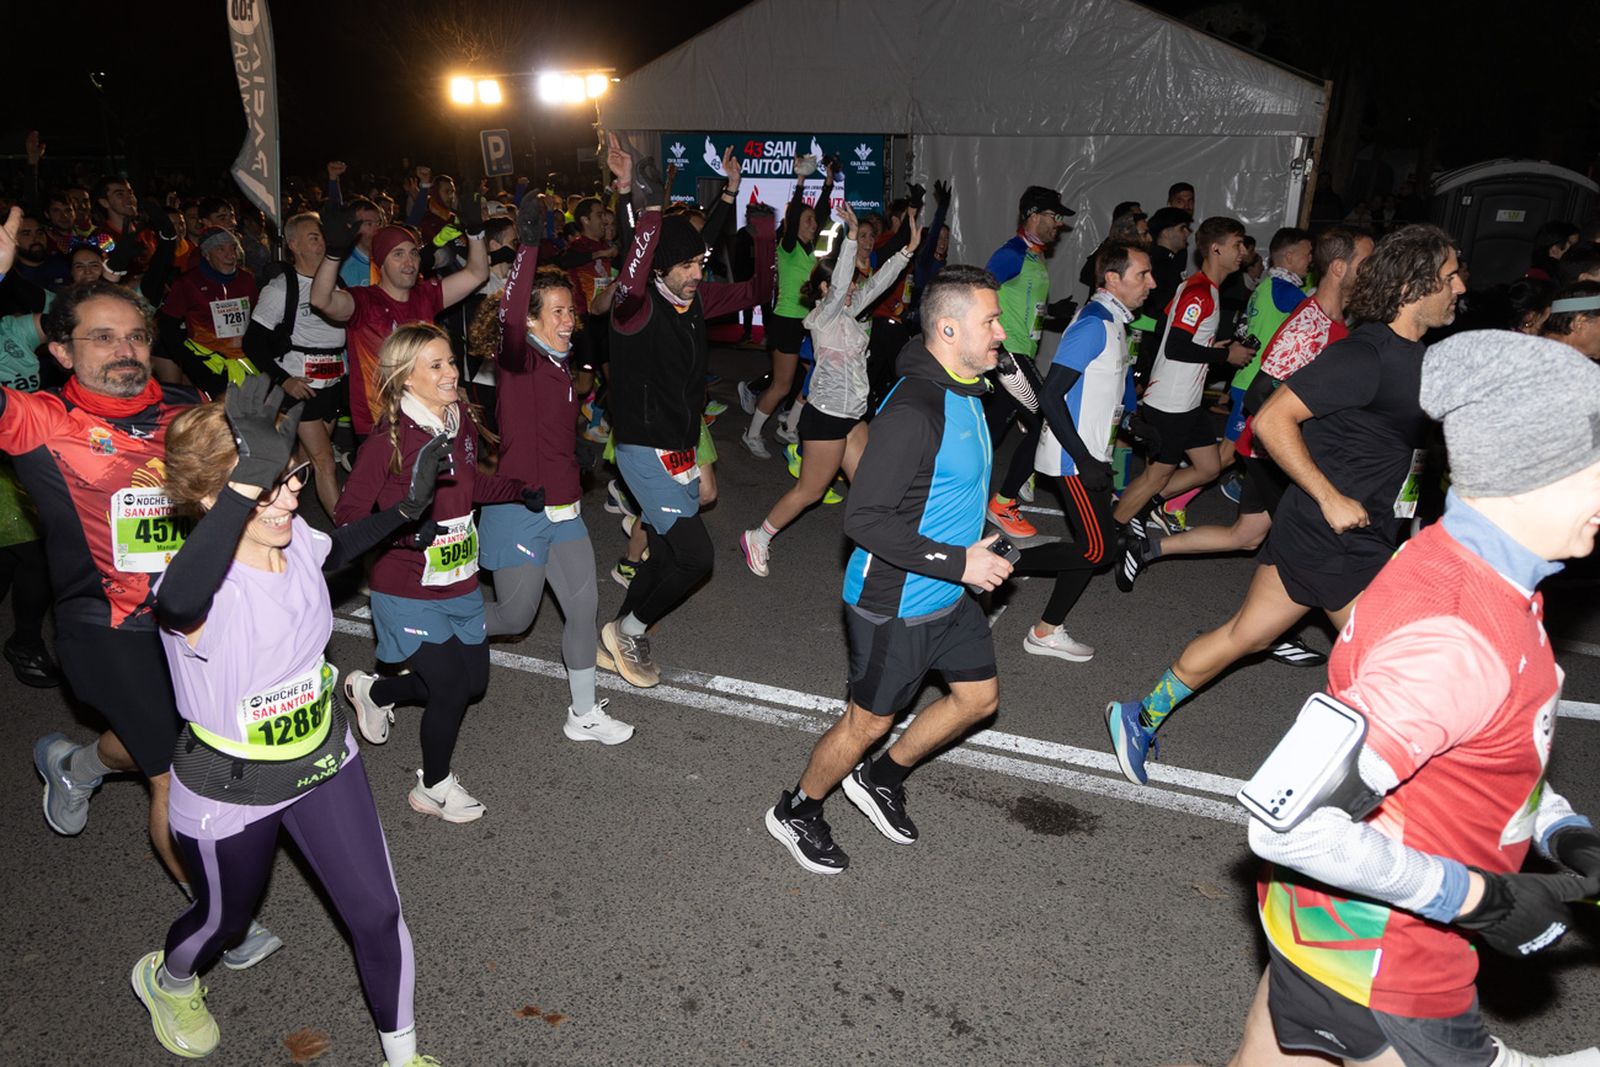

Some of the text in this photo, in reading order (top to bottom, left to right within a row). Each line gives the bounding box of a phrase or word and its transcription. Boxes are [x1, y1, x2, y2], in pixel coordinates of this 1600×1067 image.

[487, 136, 505, 171] P
[743, 140, 797, 158] 43 SAN
[740, 155, 794, 175] ANTÓN
[222, 311, 246, 325] 7281
[136, 496, 166, 506] NOCHE
[124, 507, 146, 518] SAN
[265, 686, 299, 704] NOCHE
[301, 680, 314, 693] DE
[252, 704, 277, 721] SAN
